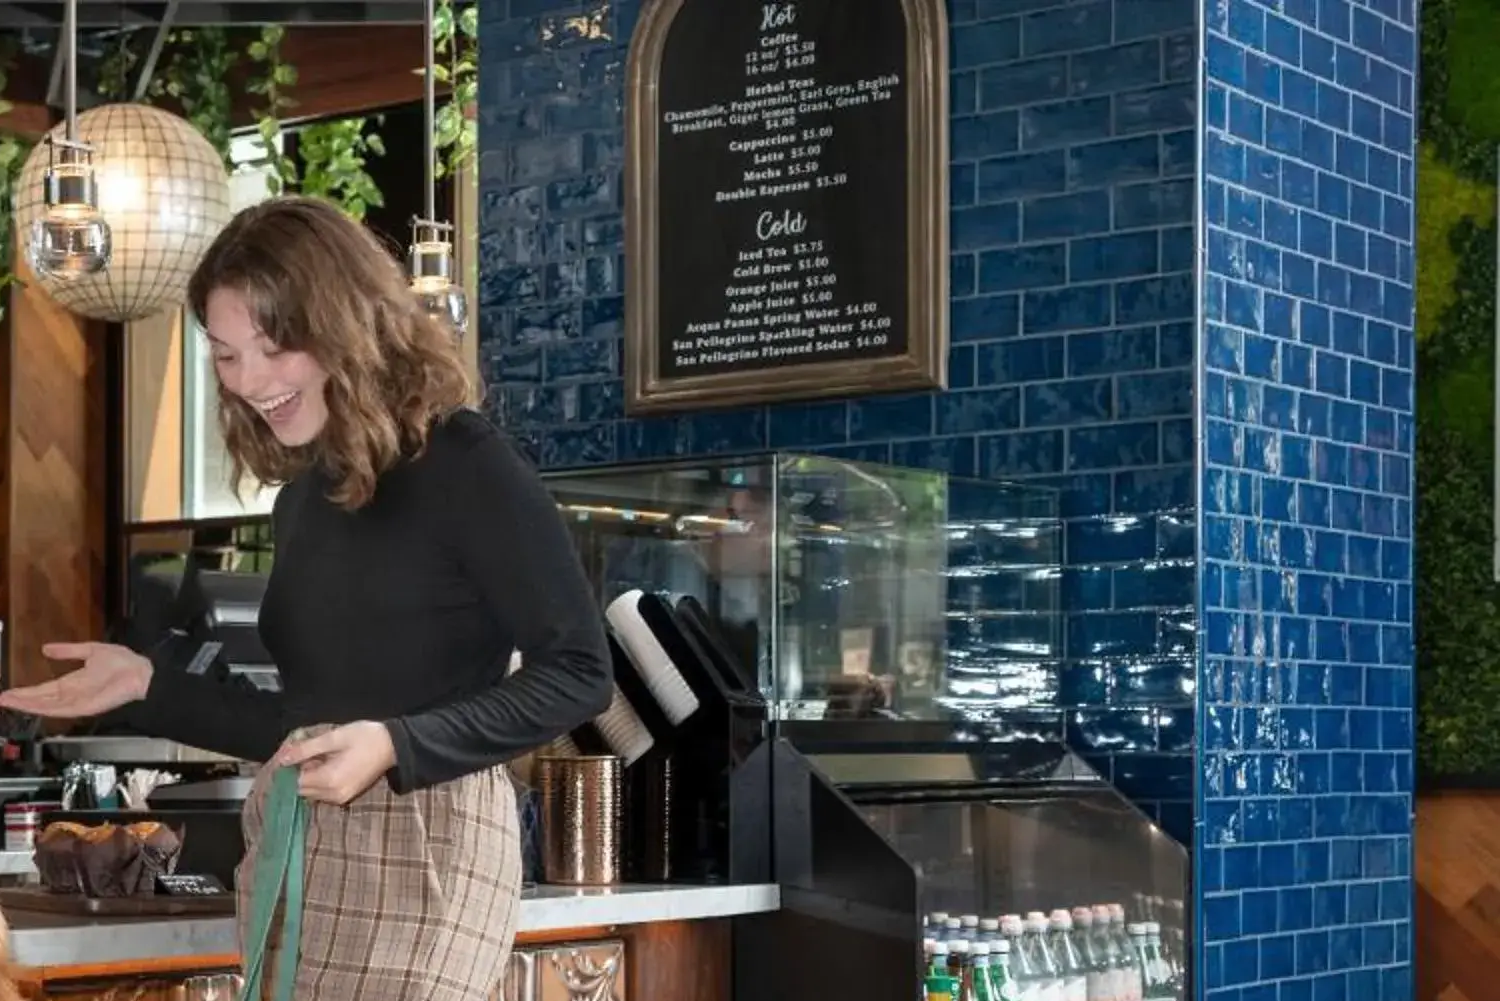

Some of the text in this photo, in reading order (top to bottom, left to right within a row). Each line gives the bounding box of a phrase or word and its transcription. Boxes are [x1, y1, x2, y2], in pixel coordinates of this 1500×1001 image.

[760, 4, 796, 31] Hot
[761, 32, 798, 47] Coffee
[745, 51, 758, 63] 12
[746, 64, 758, 76] 16
[731, 93, 797, 112] Peppermint,
[800, 87, 823, 101] Earl
[857, 73, 899, 91] English
[745, 78, 815, 97] Herbal Teas
[835, 95, 869, 108] Green
[871, 89, 891, 101] Tea
[765, 116, 797, 130] $4.00
[729, 125, 834, 152] Cappuccino $5.00
[753, 151, 784, 165] Latte
[743, 167, 781, 182] Mocha
[715, 186, 757, 202] Double
[759, 180, 811, 196] Espresso
[756, 208, 808, 240] Cold
[738, 247, 763, 262] Iced
[765, 246, 788, 258] Tea
[733, 264, 761, 278] Cold
[763, 263, 793, 275] Brew
[725, 284, 768, 297] Orange
[770, 279, 800, 293] Juice
[729, 299, 763, 314] Apple
[765, 296, 796, 310] Juice
[685, 301, 877, 334] Acqua Panna Spring Water $4.00
[672, 316, 891, 352] San Pellegrino Sparkling Water $4.00
[675, 334, 888, 368] San Pellegrino Flavored Sodas $4.00
